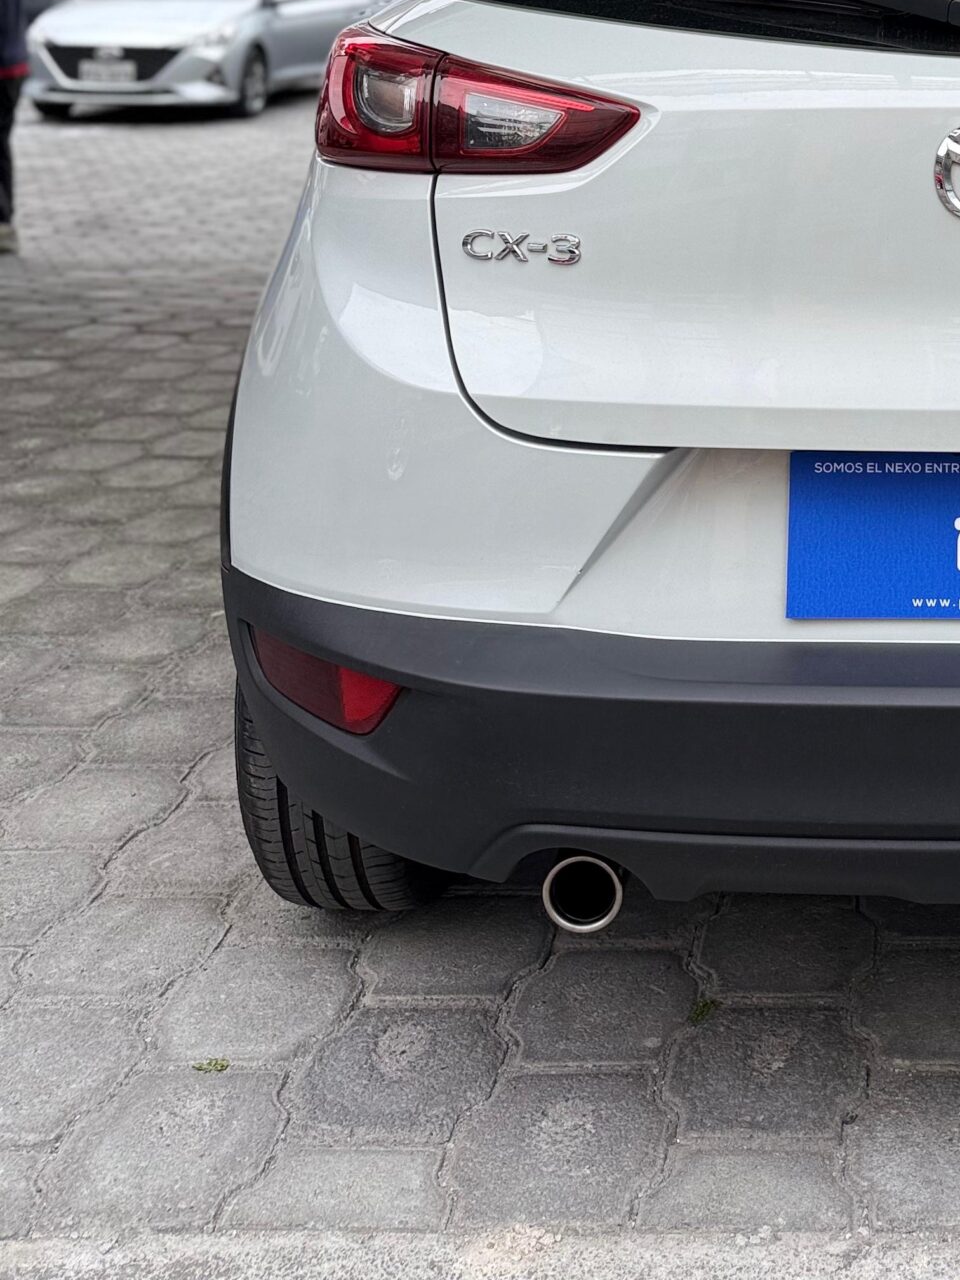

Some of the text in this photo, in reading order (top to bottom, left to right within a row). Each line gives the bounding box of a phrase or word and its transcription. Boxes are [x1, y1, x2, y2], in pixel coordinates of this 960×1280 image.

[462, 229, 581, 265] CX-3
[814, 462, 864, 473] SOMOS
[866, 462, 882, 473] EL
[885, 462, 922, 473] NEXO
